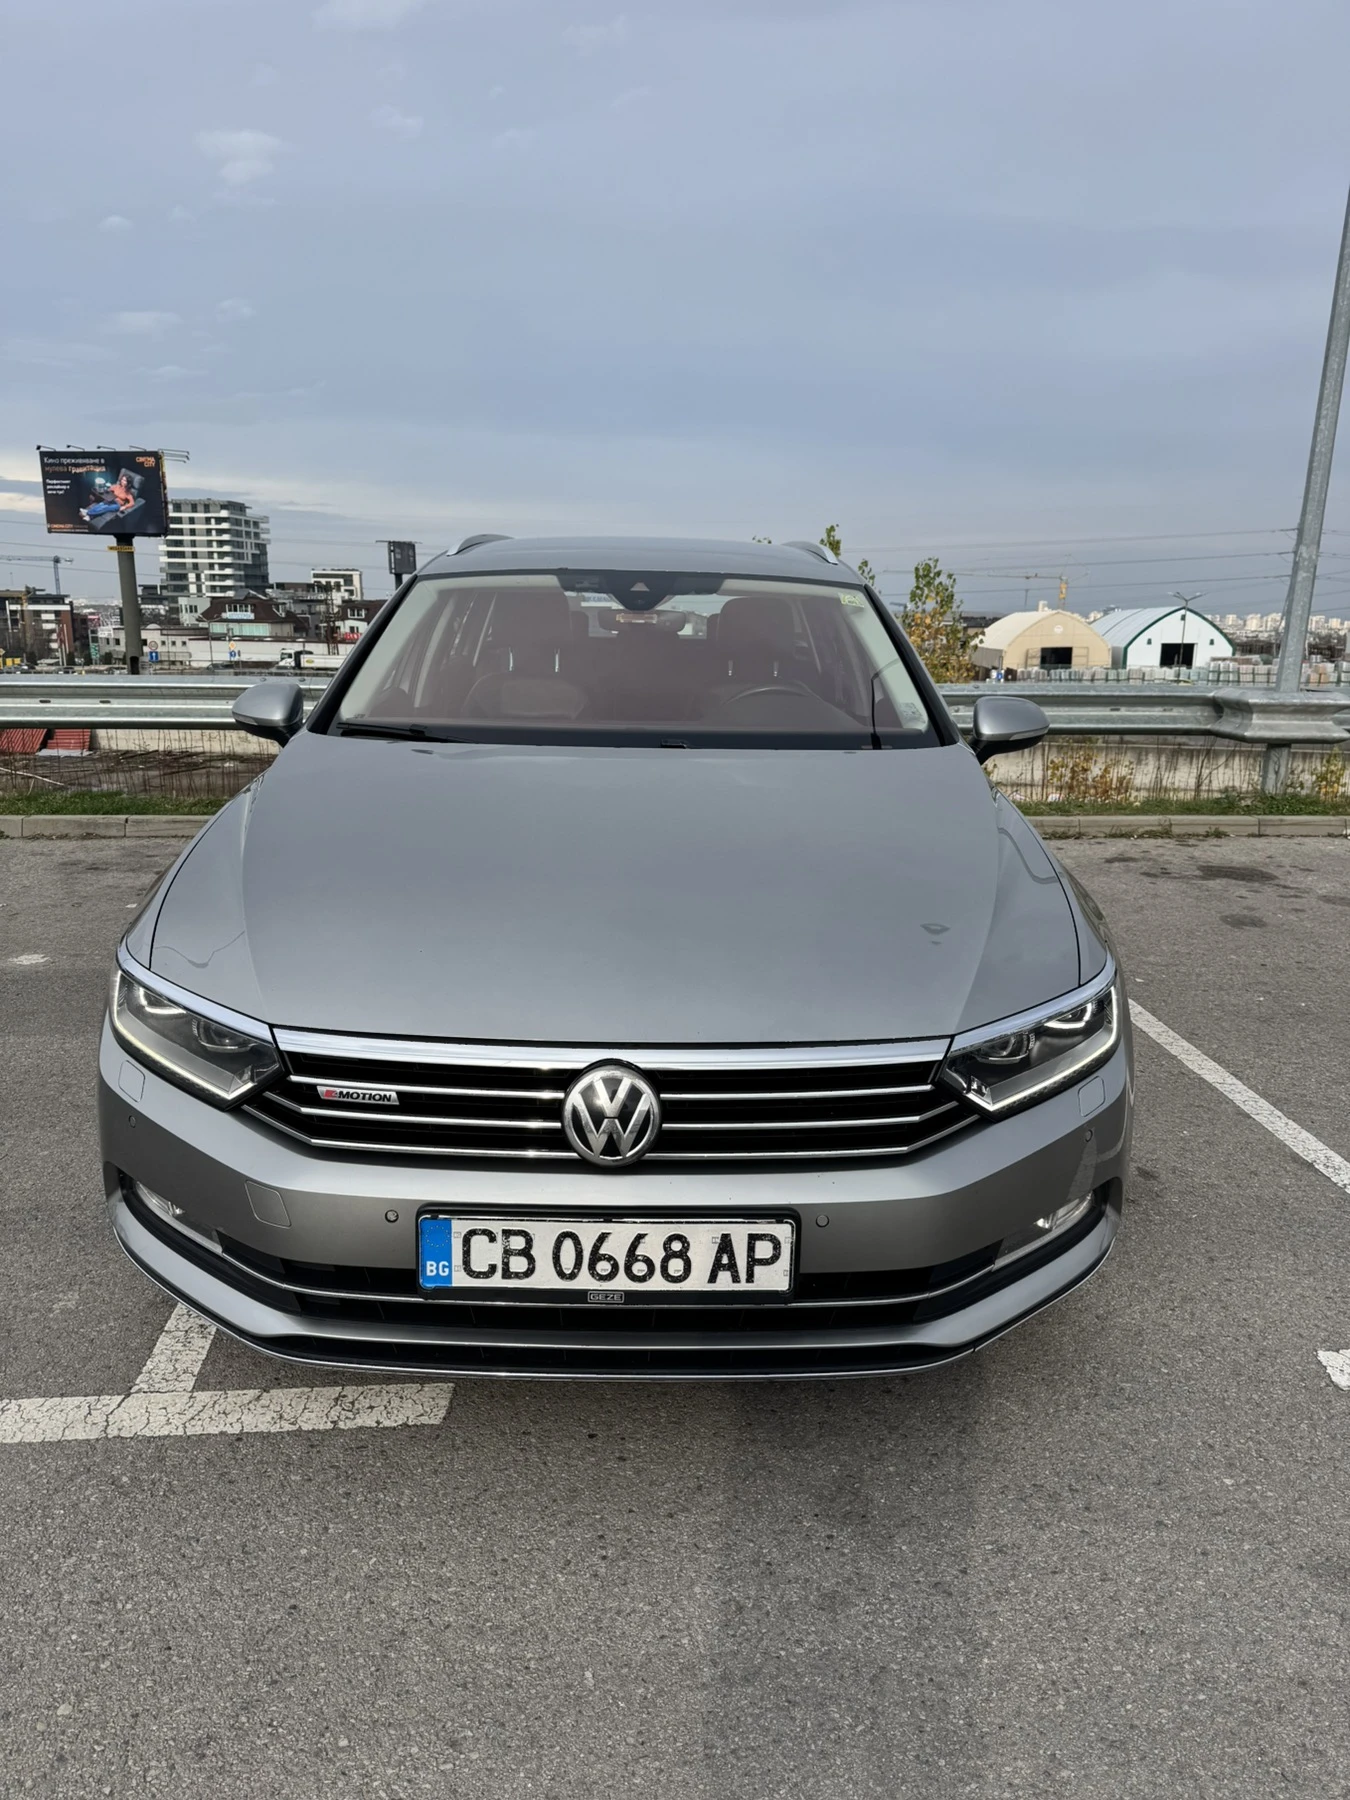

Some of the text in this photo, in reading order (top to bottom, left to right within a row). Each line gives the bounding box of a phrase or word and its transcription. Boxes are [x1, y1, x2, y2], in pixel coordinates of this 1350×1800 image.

[462, 1228, 782, 1284] CB 0668 AP
[426, 1261, 449, 1276] BG
[590, 1293, 622, 1301] GEZE
